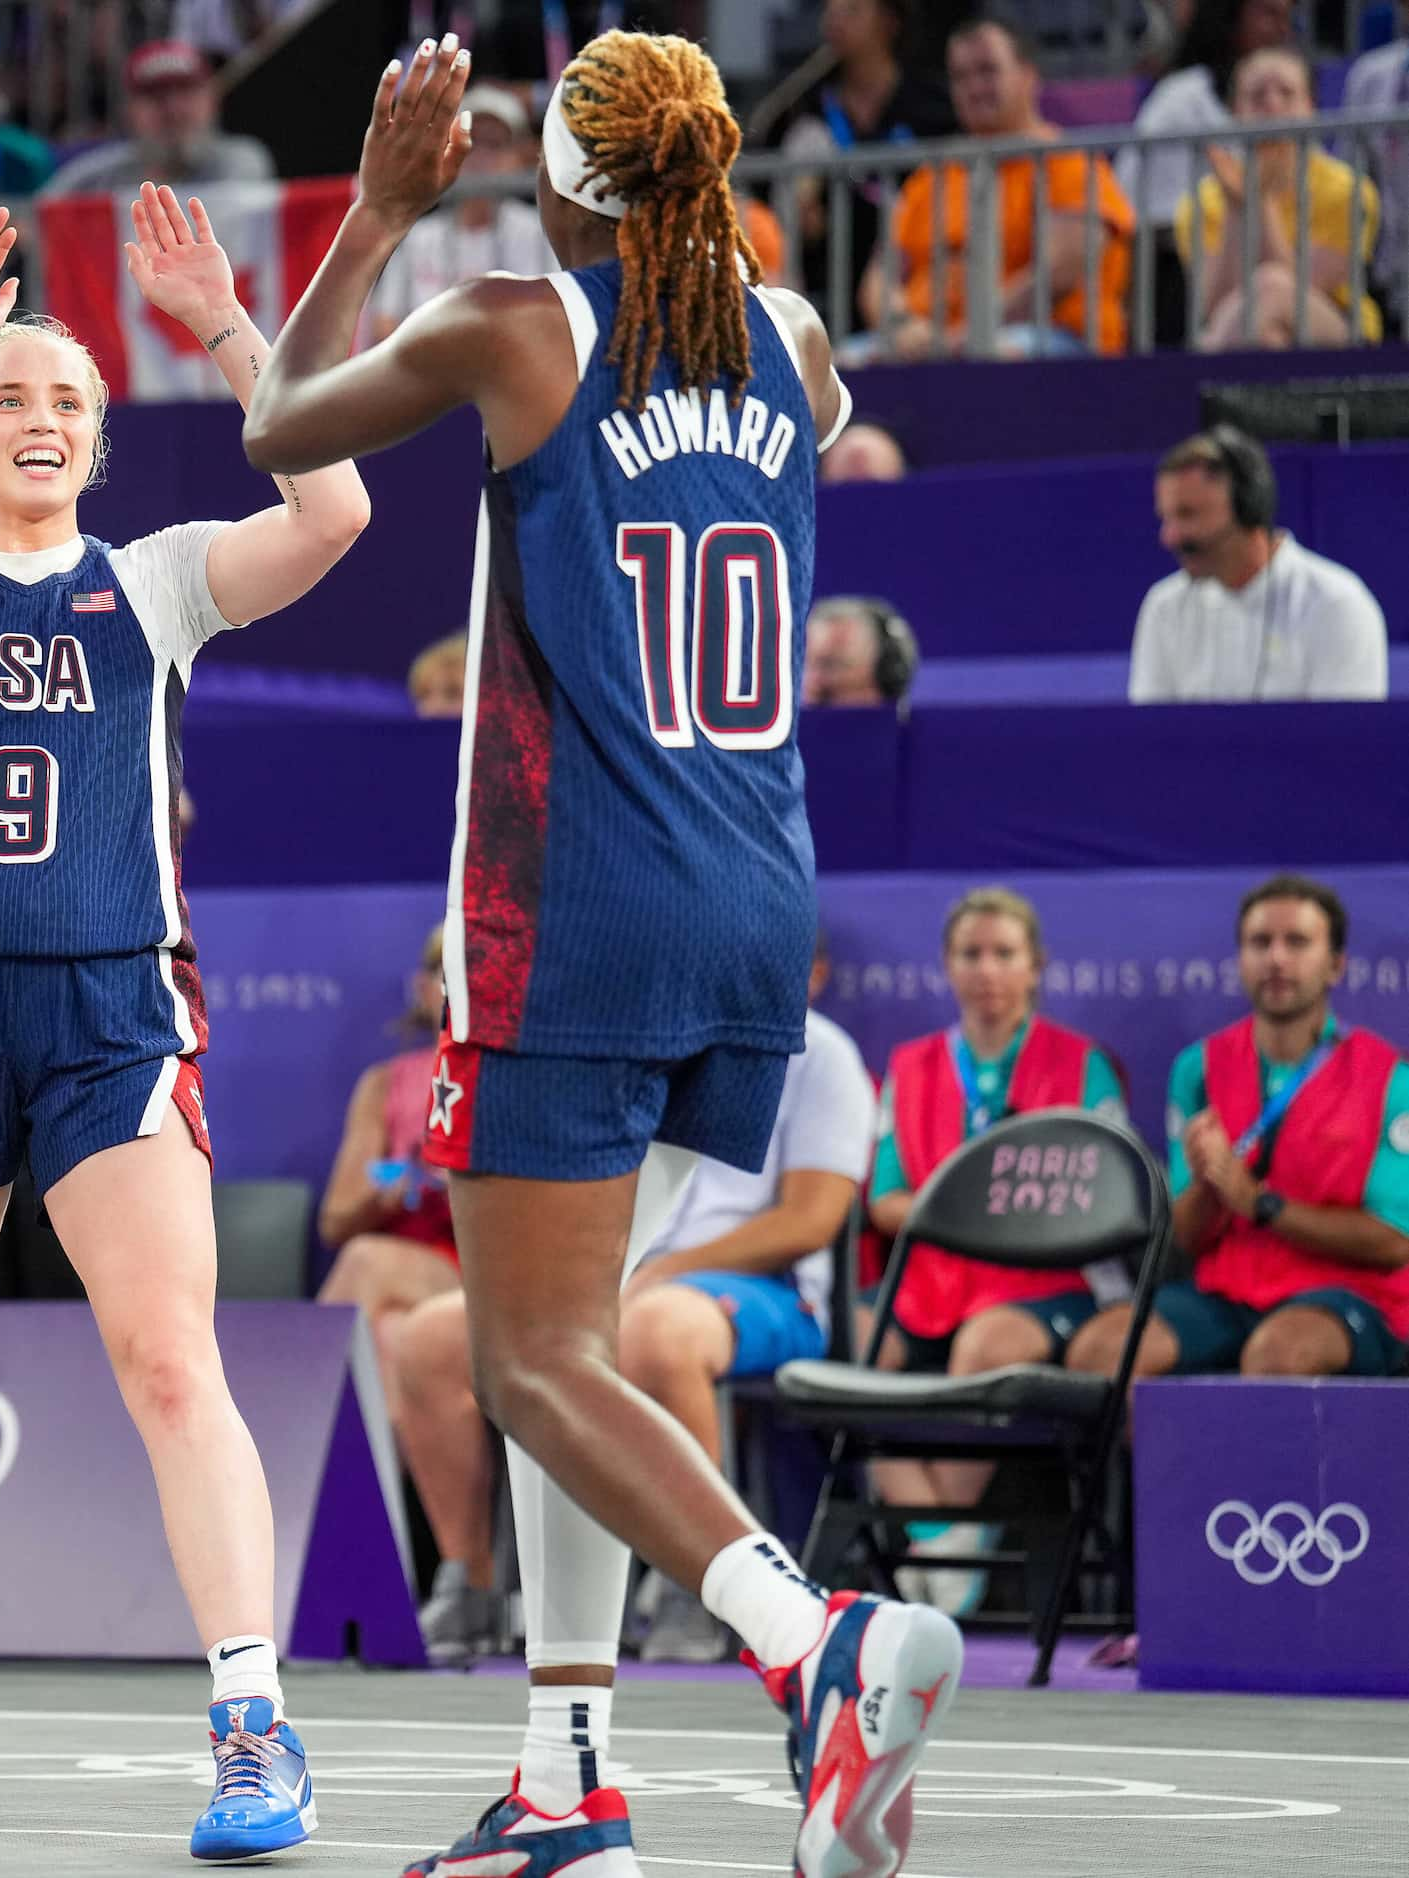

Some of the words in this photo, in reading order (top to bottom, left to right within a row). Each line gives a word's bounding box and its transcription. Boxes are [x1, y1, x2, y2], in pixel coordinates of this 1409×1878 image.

[598, 386, 795, 480] HOWARD
[615, 520, 795, 751] 10
[991, 1143, 1101, 1180] PARIS
[987, 1179, 1094, 1216] 2024
